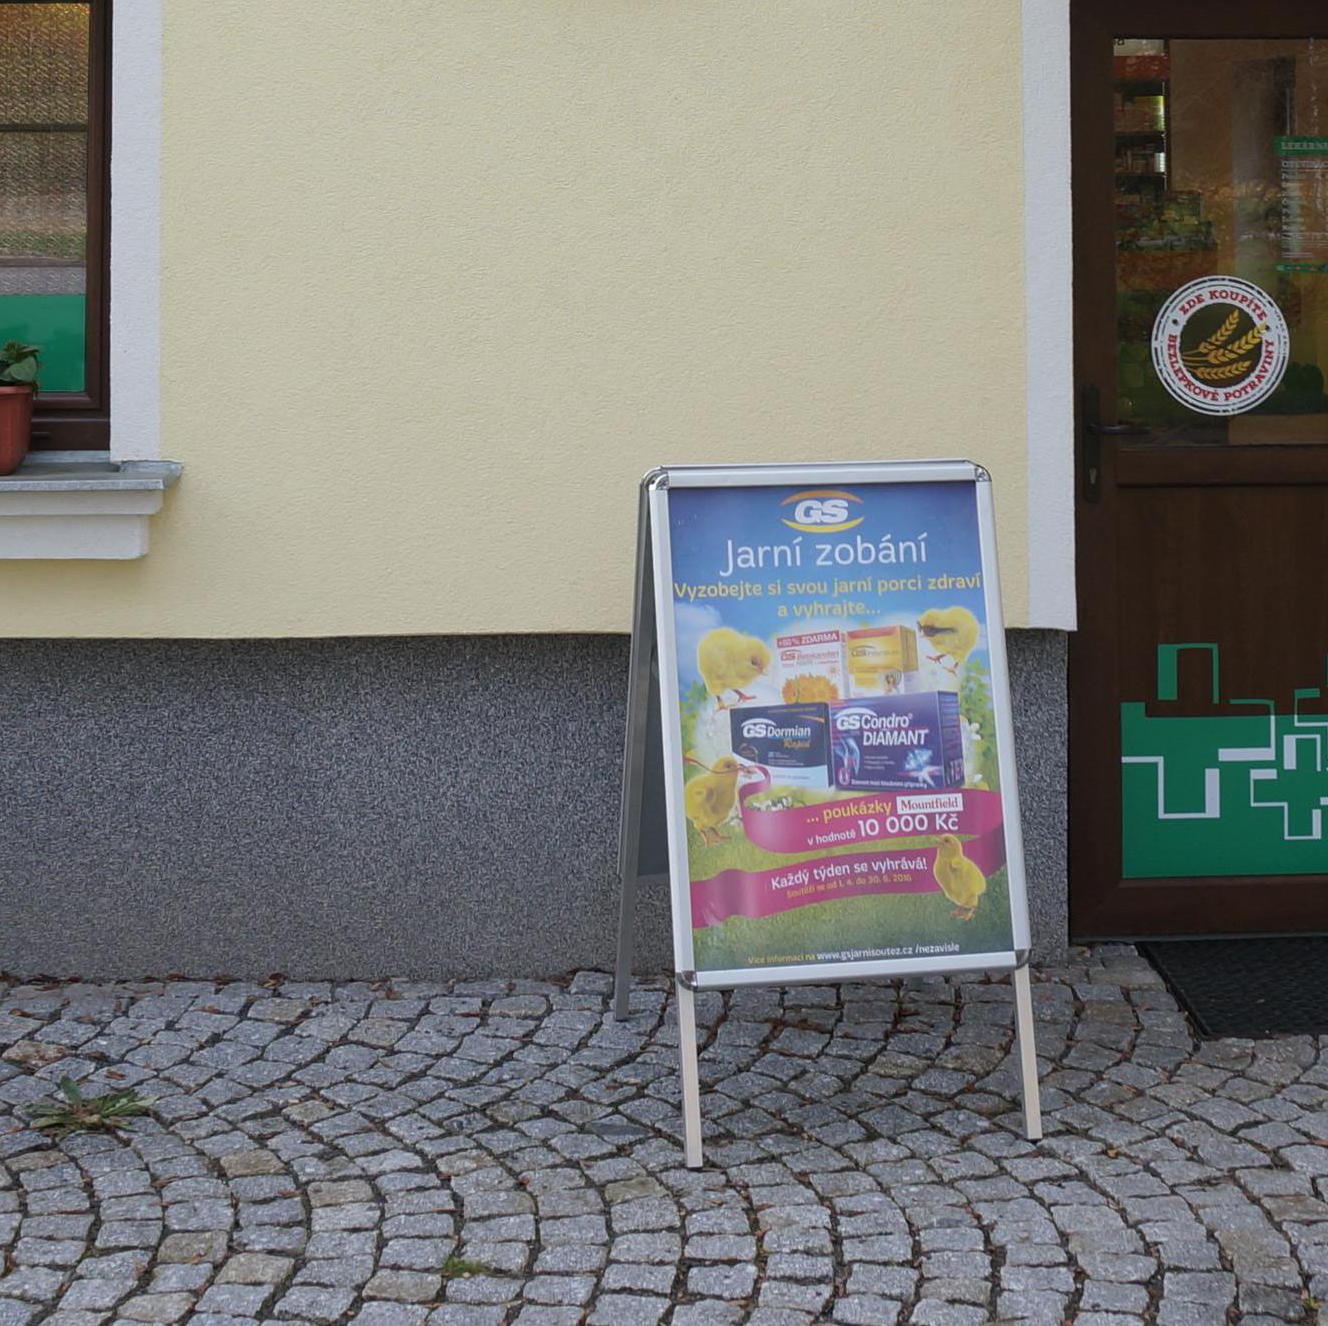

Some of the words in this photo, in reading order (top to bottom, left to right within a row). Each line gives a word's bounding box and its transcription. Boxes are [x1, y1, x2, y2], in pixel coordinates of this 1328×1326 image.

[1179, 294, 1205, 315] ZDE
[1208, 289, 1268, 321] KOUPÍTE
[1167, 334, 1219, 401] BEZLEPKOVÉ
[1224, 339, 1274, 401] POTRAVINY
[794, 498, 849, 524] GS
[719, 536, 803, 577] Jarní
[815, 532, 928, 566] zobání
[674, 581, 762, 603] Vyzobejte
[768, 579, 782, 595] si
[787, 581, 828, 595] svou
[832, 576, 872, 598] jarní
[877, 575, 922, 596] porci
[928, 572, 981, 590] zdraví
[778, 604, 788, 618] a
[801, 631, 838, 644] ZDARMA
[742, 723, 767, 738] GS
[767, 725, 811, 738] Dormian
[836, 715, 861, 730] GS
[862, 729, 929, 746] DIAMANT
[823, 799, 892, 823] poukázky
[900, 795, 959, 811] Mountfield
[807, 837, 814, 846] v
[815, 828, 856, 844] hodnotě
[858, 818, 879, 837] 10
[886, 814, 928, 833] 000
[935, 813, 959, 831] Kč
[771, 870, 810, 891] Každý
[813, 864, 850, 882] týden
[854, 862, 869, 873] se
[871, 857, 928, 874] vyhrává!
